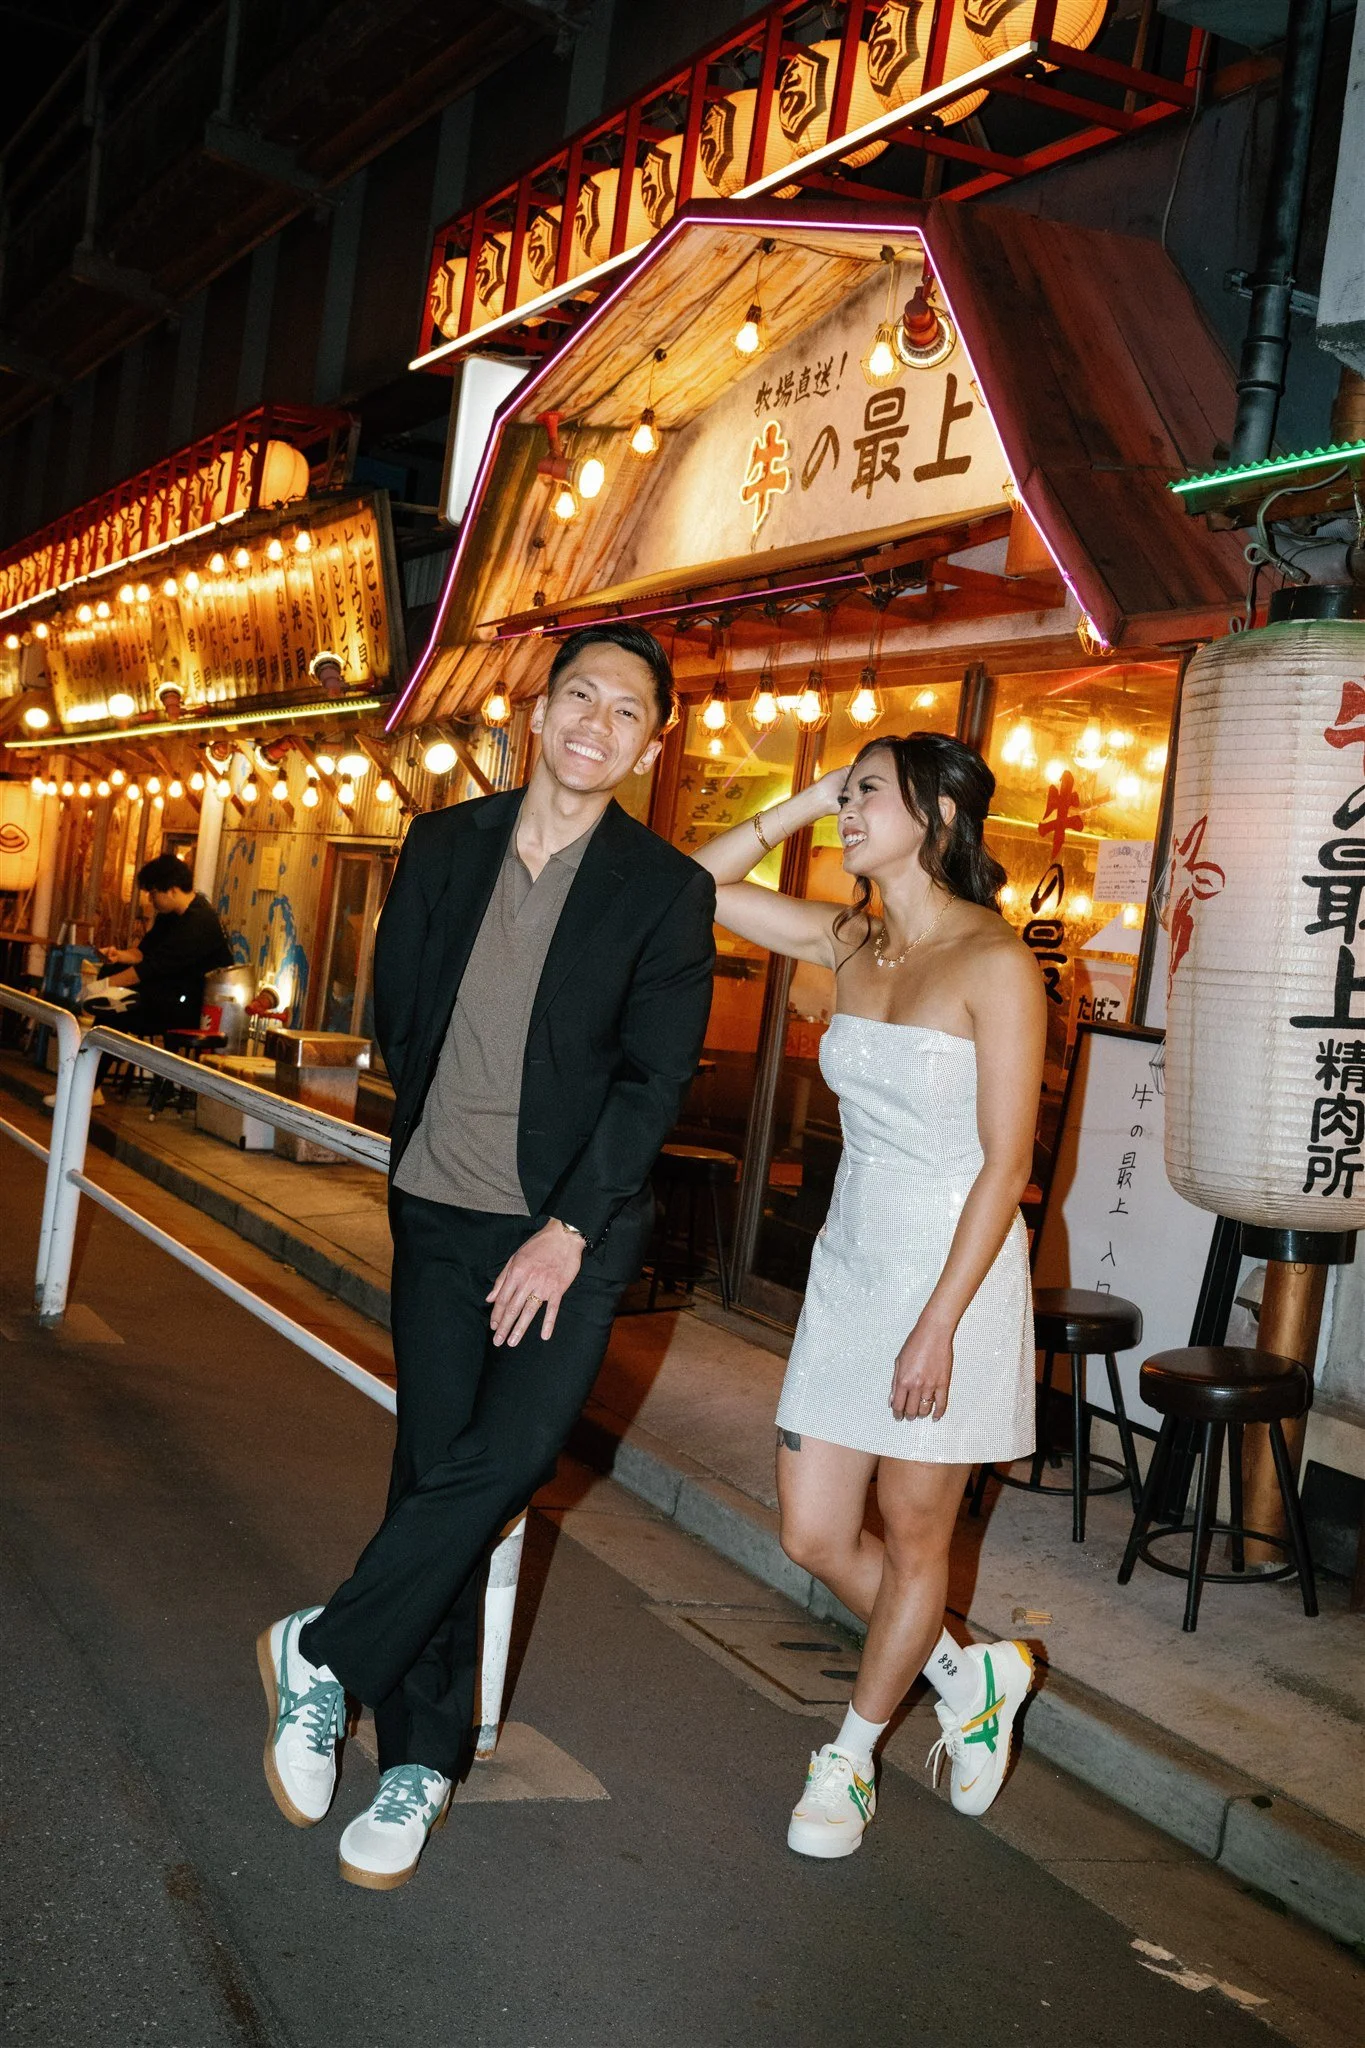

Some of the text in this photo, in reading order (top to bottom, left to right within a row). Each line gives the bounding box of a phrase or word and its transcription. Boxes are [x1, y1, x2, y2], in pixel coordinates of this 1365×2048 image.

[754, 350, 848, 417] 牧場直送!
[740, 372, 974, 533] 牛の最上
[1076, 994, 1122, 1022] たばこ
[1108, 1083, 1153, 1216] 牛の最上
